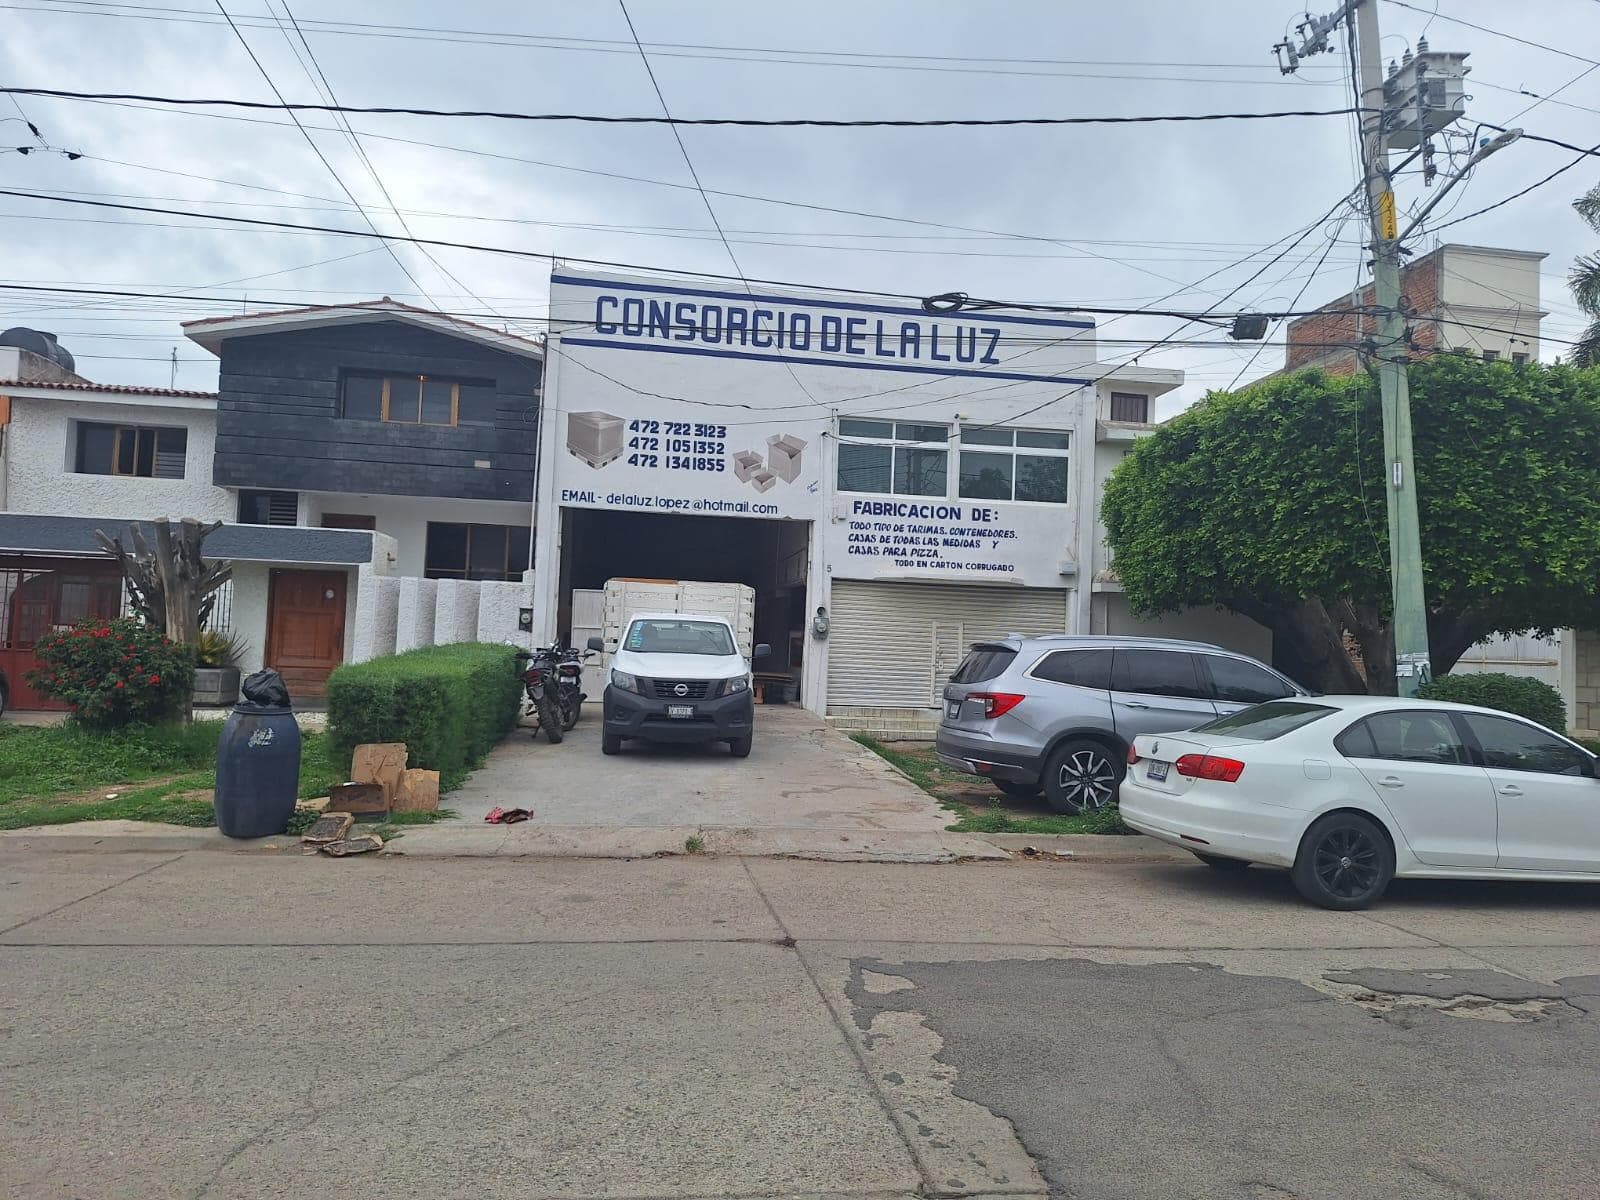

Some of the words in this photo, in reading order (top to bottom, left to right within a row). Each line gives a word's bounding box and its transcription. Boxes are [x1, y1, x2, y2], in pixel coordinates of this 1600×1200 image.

[595, 295, 811, 351] CONSORCIO
[820, 315, 867, 355] DE
[875, 319, 921, 359] LA
[930, 324, 1001, 365] LUZ
[629, 419, 660, 434] 472
[663, 421, 691, 436] 722
[694, 423, 727, 439] 3123
[628, 436, 659, 451] 472
[627, 453, 658, 468] 472
[853, 500, 962, 521] FABRICACION
[971, 507, 999, 523] DE:
[849, 521, 872, 531] TODO
[873, 522, 892, 532] TIPO
[893, 524, 905, 533] DE
[848, 533, 877, 543] CAJAS
[879, 535, 891, 544] DE
[893, 535, 921, 546] TODAS
[922, 537, 940, 547] LAS
[942, 539, 981, 549] MEDIDAS
[992, 540, 1000, 550] Y
[848, 545, 880, 556] CAJAS
[882, 546, 907, 557] PARA
[894, 559, 914, 568] TODO
[916, 560, 928, 569] EN
[930, 561, 963, 570] CARTON
[965, 562, 1015, 573] CORRUGADO
